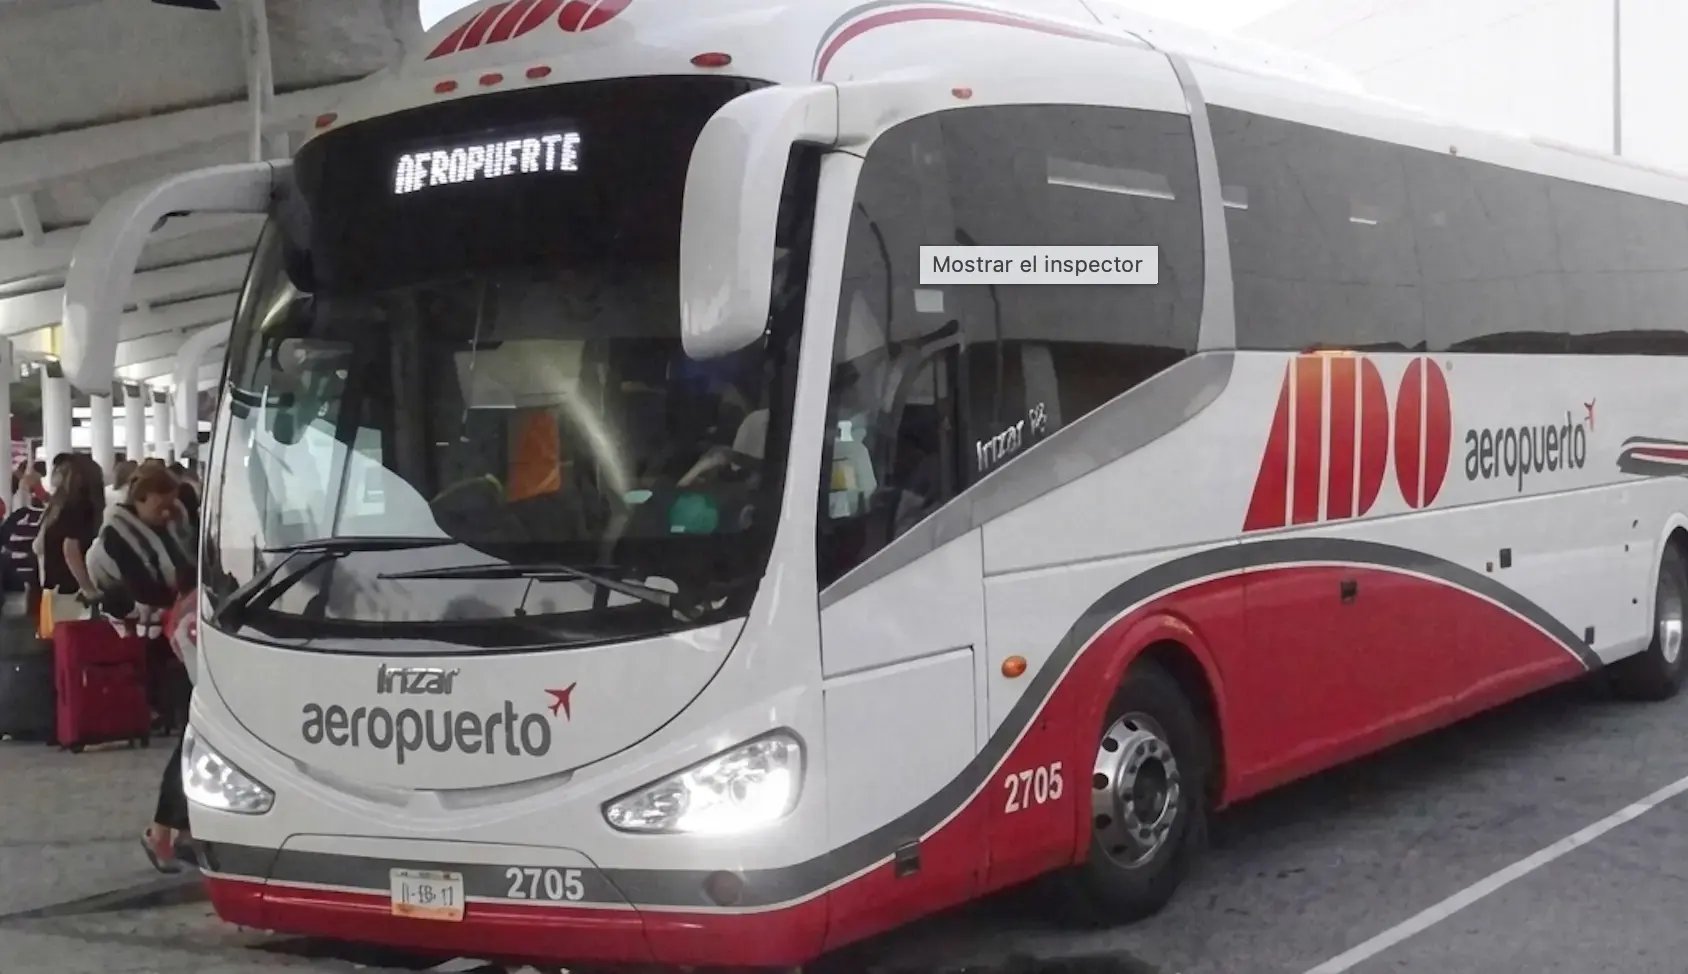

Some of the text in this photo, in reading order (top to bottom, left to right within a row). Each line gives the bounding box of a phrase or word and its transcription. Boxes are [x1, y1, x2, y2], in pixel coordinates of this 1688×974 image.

[1241, 356, 1452, 532] ADO
[1465, 410, 1586, 492] aeropuerto
[302, 700, 551, 765] aeropuerto
[1004, 761, 1063, 813] 2705
[505, 867, 585, 900] 2705
